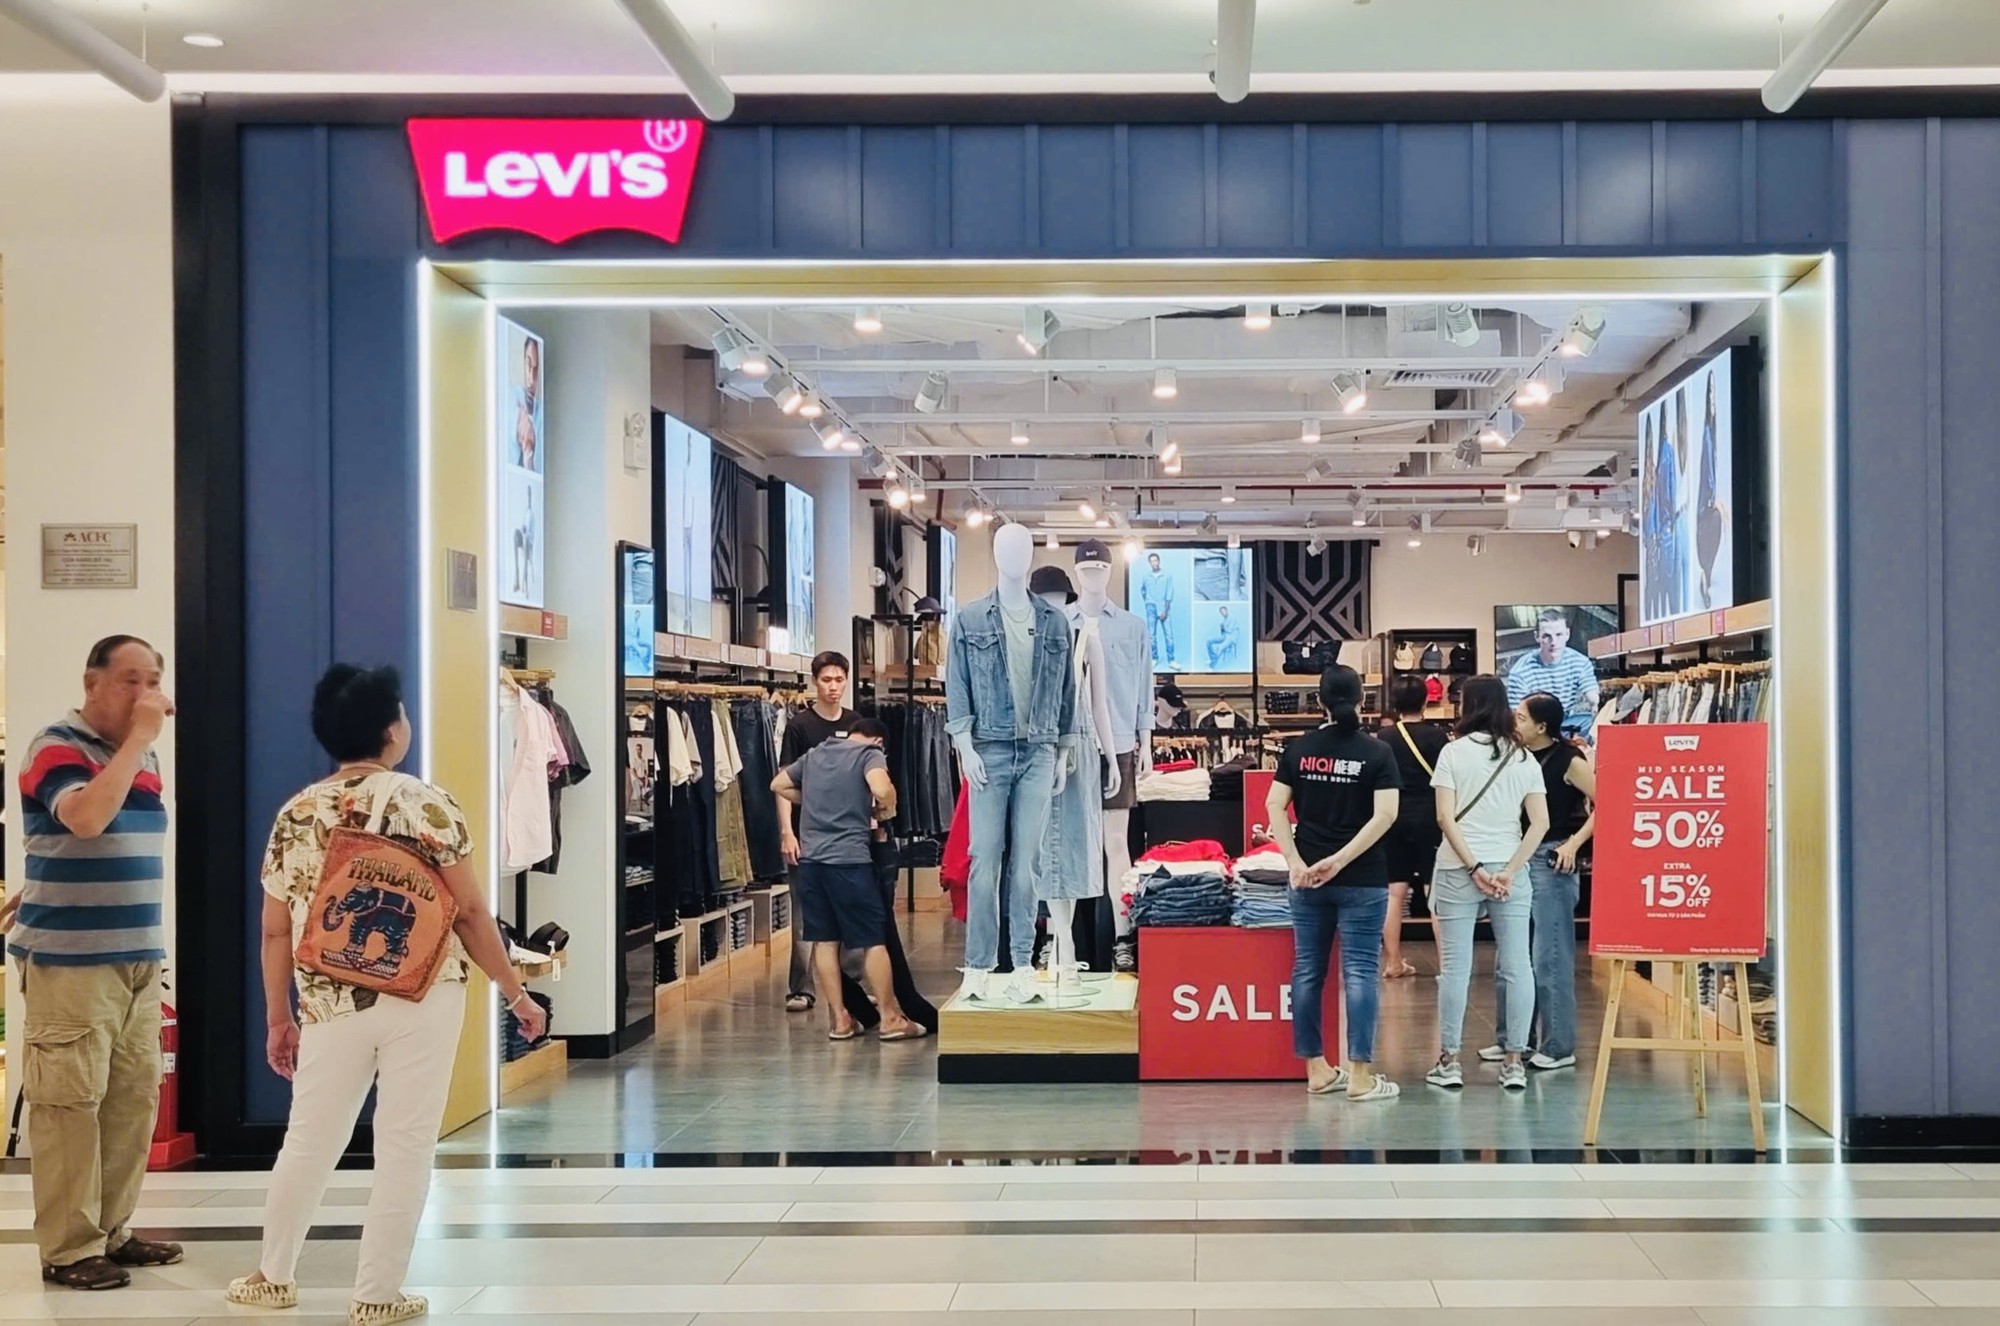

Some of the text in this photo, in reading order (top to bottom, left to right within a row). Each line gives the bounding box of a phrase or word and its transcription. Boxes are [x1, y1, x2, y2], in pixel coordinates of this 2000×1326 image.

[1638, 765, 1726, 774] MID SEASON
[1634, 775, 1726, 800] SALE
[1631, 809, 1726, 849] 50%
[1695, 836, 1724, 849] OFF
[1663, 862, 1692, 870] EXTRA
[346, 856, 438, 902] THAILAND
[1640, 873, 1712, 908] 15%
[1686, 897, 1711, 908] OFF
